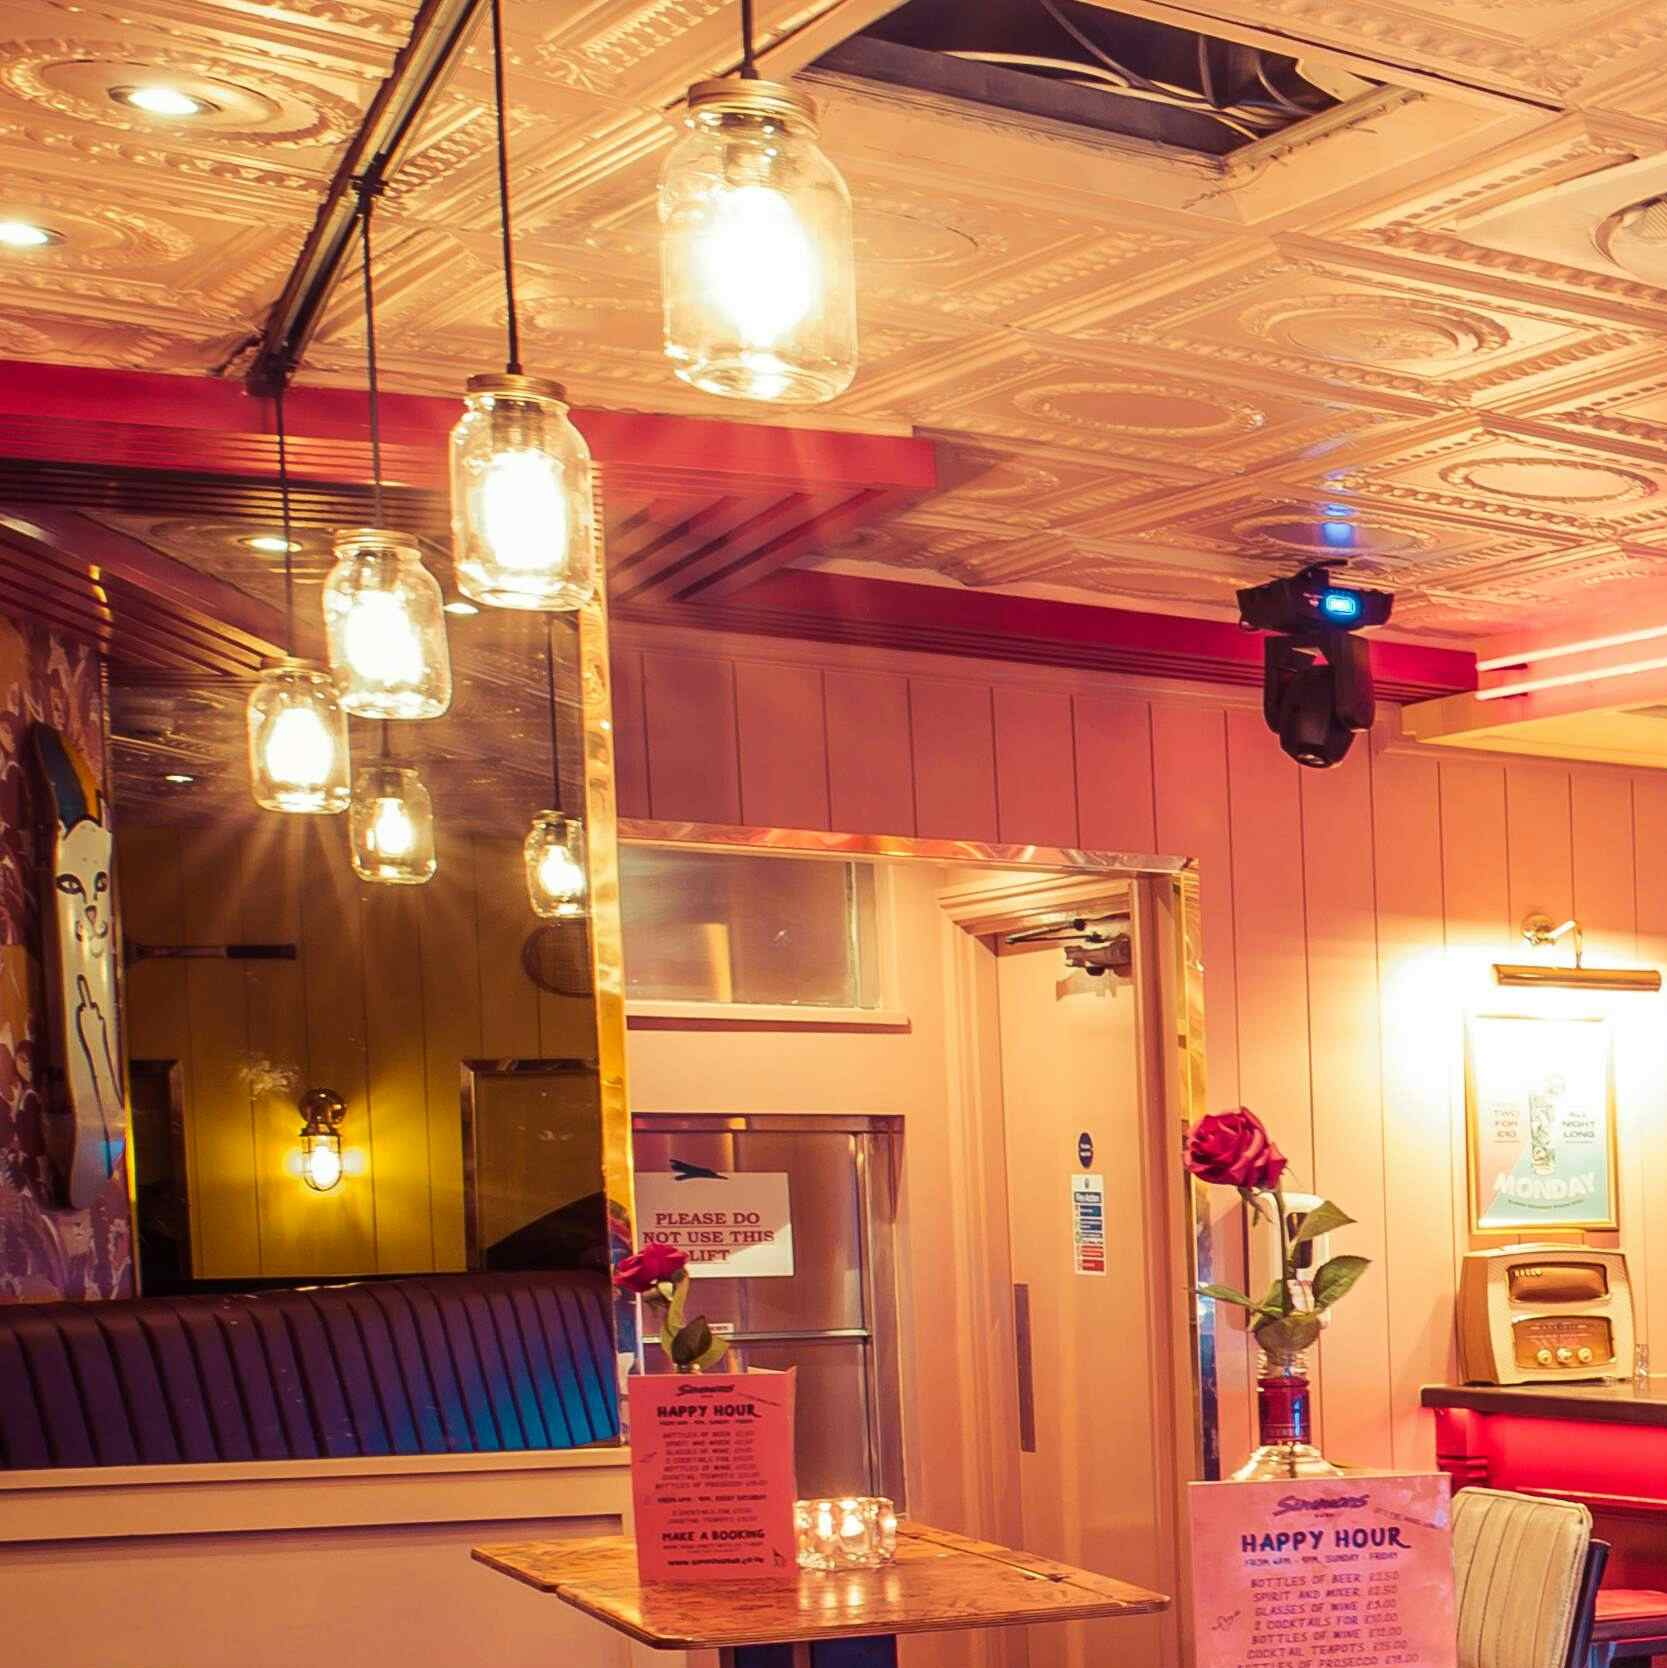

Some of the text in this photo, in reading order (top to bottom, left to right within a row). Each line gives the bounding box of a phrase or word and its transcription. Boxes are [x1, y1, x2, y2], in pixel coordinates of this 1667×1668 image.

[1493, 1171, 1599, 1200] MONDAY
[655, 1212, 761, 1225] PLEASE DO
[643, 1230, 776, 1243] NOT USE THIS
[688, 1249, 730, 1262] LIFT
[657, 1403, 762, 1418] HAPPY HOUR
[662, 1529, 765, 1541] MAKE A BOOKING
[1241, 1527, 1411, 1552] HAPPY HOUR
[1251, 1576, 1306, 1588] BOTTLES
[1312, 1574, 1326, 1584] OF
[1331, 1573, 1361, 1583] BEER
[1254, 1591, 1290, 1601] SPIRIT
[1298, 1590, 1320, 1599] AND
[1325, 1587, 1360, 1597] MIXER
[1255, 1605, 1305, 1616] GLASSES
[1311, 1603, 1325, 1613] OF
[1331, 1601, 1357, 1611] WINE
[1266, 1617, 1331, 1630] COCKTAILS
[1336, 1615, 1358, 1625] FOR
[1252, 1632, 1308, 1645] BOTTLES
[1313, 1631, 1328, 1641] OF
[1333, 1629, 1360, 1639] WINE
[1247, 1647, 1305, 1659] COCKTAIL
[1310, 1643, 1364, 1655] TEAPOTS
[1319, 1656, 1378, 1668] PROSECCO
